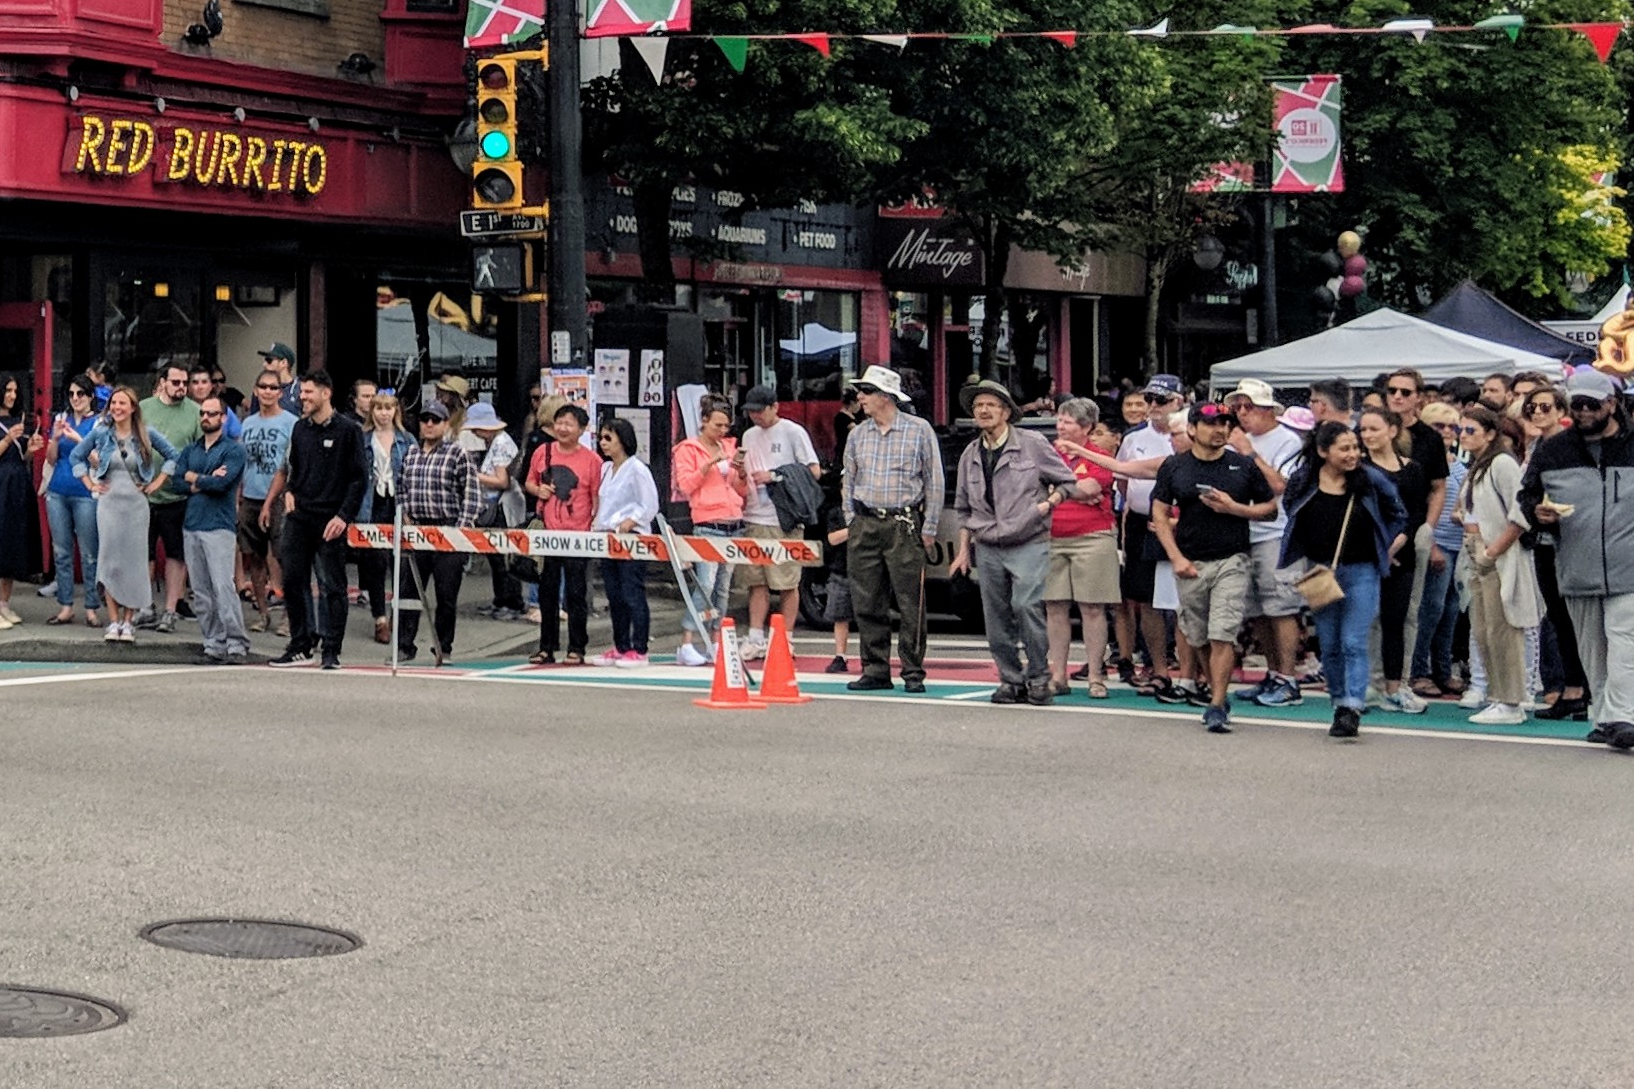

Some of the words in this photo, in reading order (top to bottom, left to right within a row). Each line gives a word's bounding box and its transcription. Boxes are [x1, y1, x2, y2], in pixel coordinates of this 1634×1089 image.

[74, 115, 155, 175] RED
[168, 126, 328, 195] BURRITO
[471, 214, 483, 231] E
[616, 216, 638, 233] DOG
[717, 226, 766, 245] AQUARIUMS
[799, 232, 814, 247] PET
[815, 234, 836, 249] FOOD
[488, 532, 523, 549] CITY
[534, 536, 571, 550] SNOW
[574, 538, 582, 550] &
[585, 538, 604, 552] ICE
